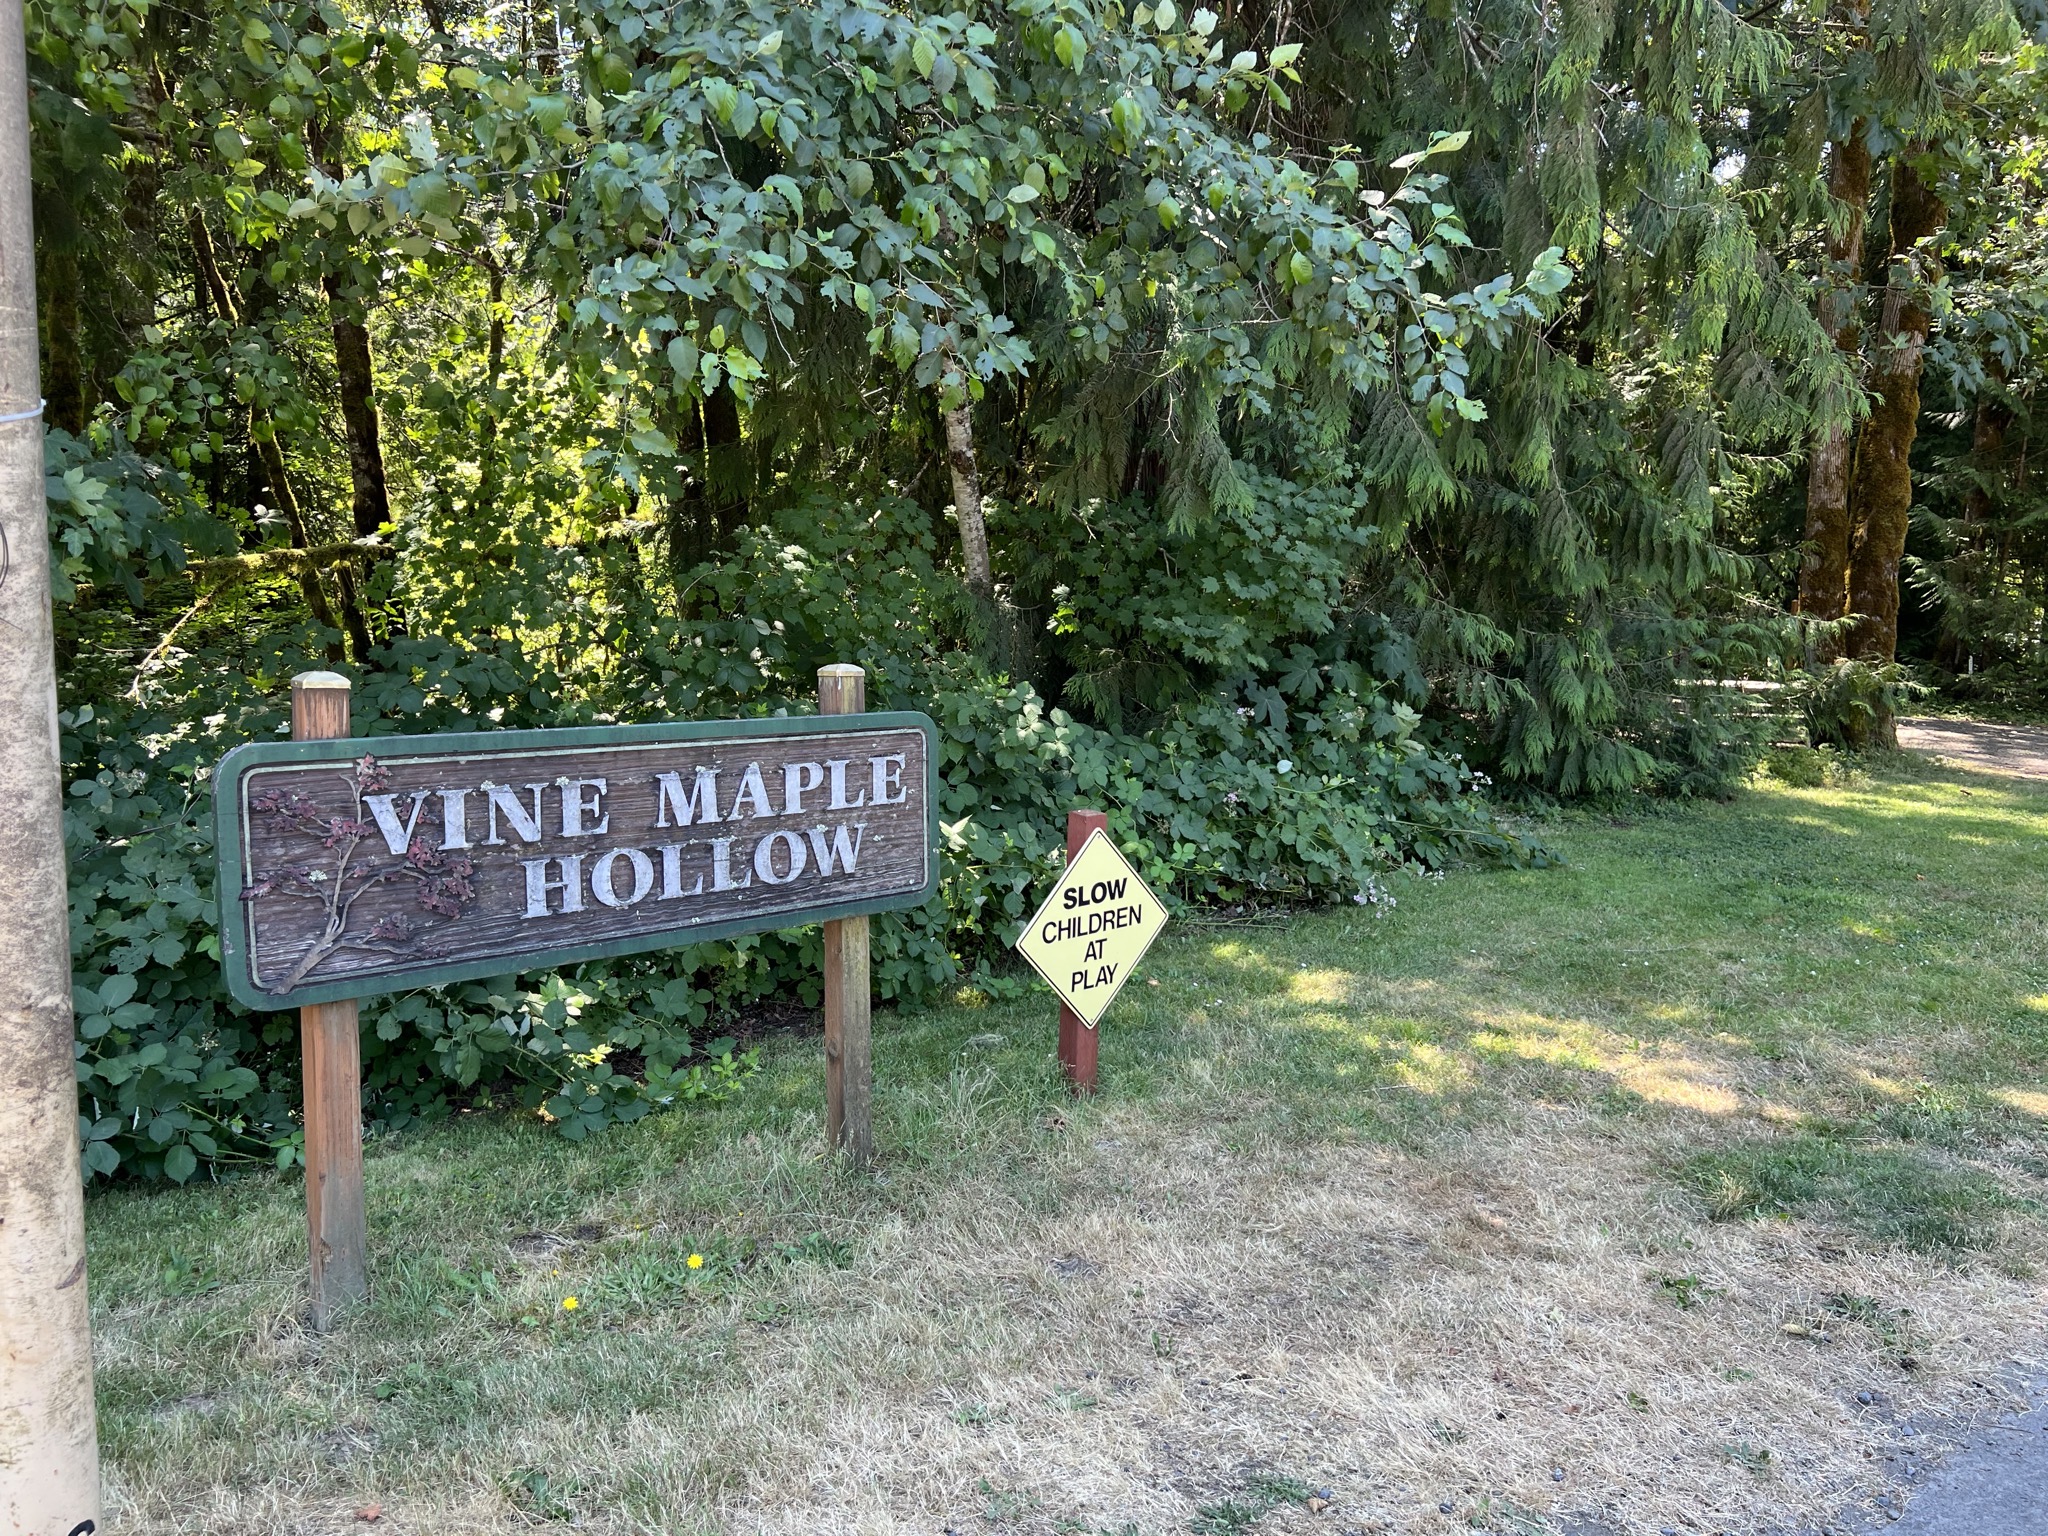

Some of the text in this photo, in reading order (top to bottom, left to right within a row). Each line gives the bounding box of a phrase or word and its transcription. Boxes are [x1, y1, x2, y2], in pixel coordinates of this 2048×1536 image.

[361, 753, 907, 855] VINE MAPLE
[522, 823, 867, 919] HOLLOW
[1063, 877, 1127, 910] SLOW
[1042, 904, 1142, 944] CHILDREN
[1084, 938, 1107, 962] AT
[1071, 963, 1118, 992] PLAY
